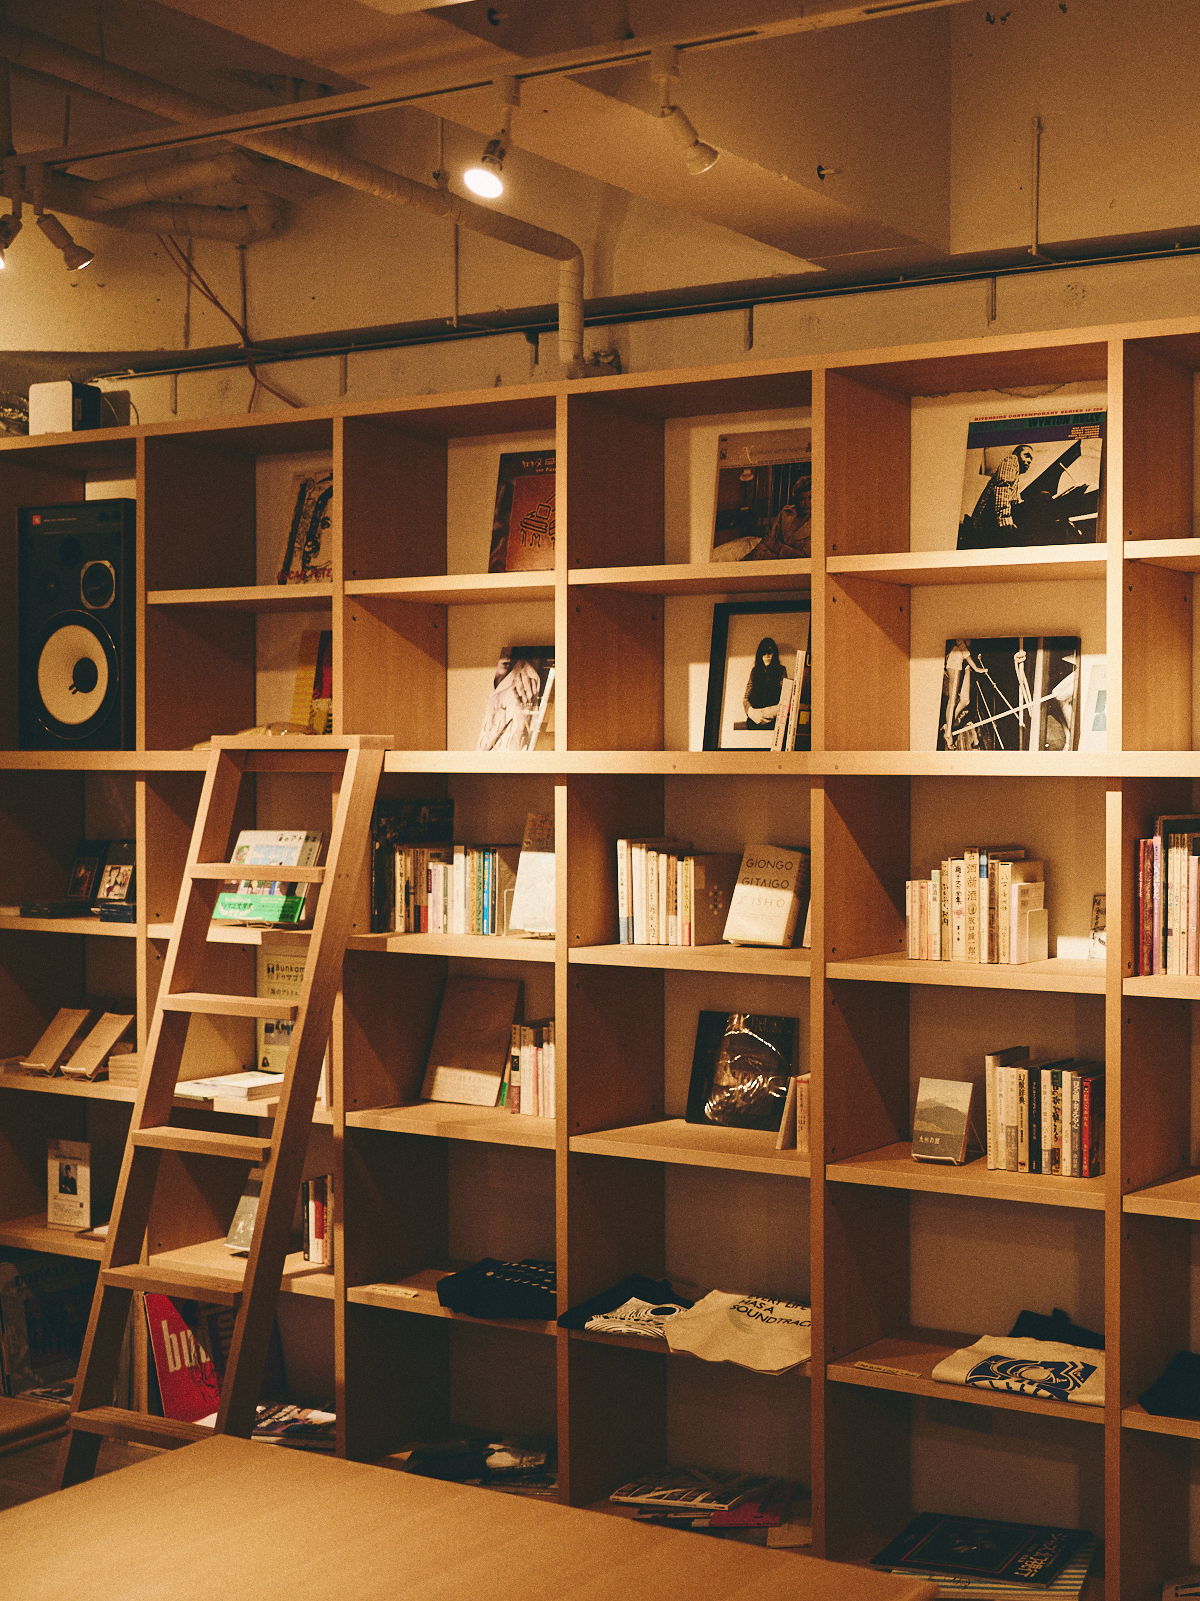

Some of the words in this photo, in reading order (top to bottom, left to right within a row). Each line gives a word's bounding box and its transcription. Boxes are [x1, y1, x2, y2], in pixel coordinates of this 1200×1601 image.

[1008, 409, 1059, 420] CONTEMPORARY
[1028, 415, 1070, 428] WYNTON
[1072, 412, 1101, 425] KELLY
[745, 857, 794, 871] GIONGO
[740, 877, 790, 890] GITAIGO
[739, 1299, 766, 1309] HAS
[763, 1306, 775, 1315] A
[747, 1294, 782, 1306] EVERY
[729, 1304, 812, 1327] SOUNDTRAC
